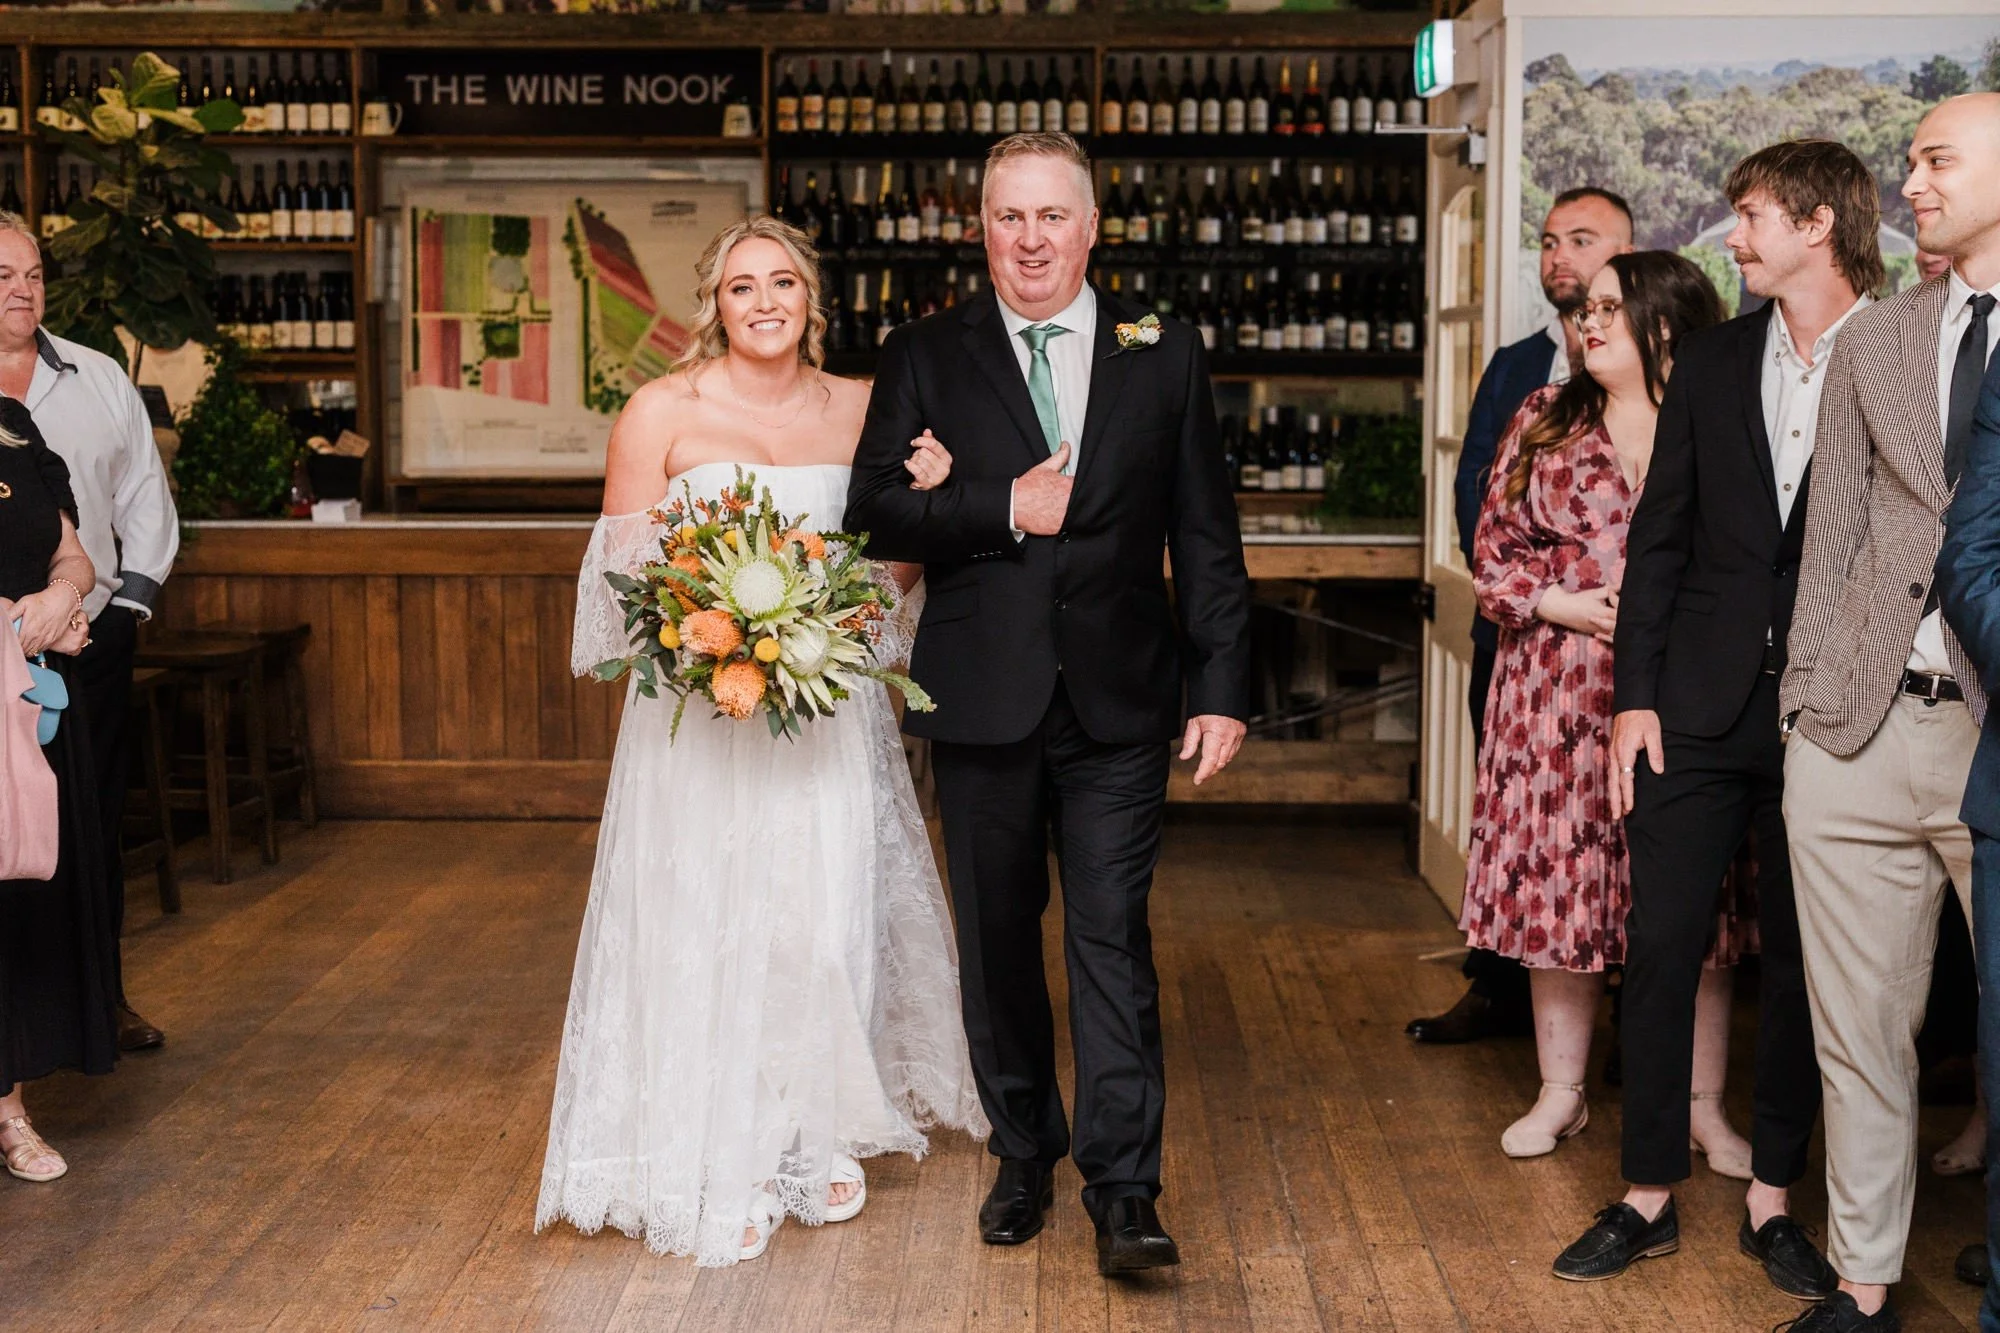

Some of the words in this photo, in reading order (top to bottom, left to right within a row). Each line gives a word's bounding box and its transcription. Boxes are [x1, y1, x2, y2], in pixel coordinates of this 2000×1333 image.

[405, 74, 487, 104] THE
[505, 74, 604, 104] WINE
[623, 74, 733, 104] NOOK
